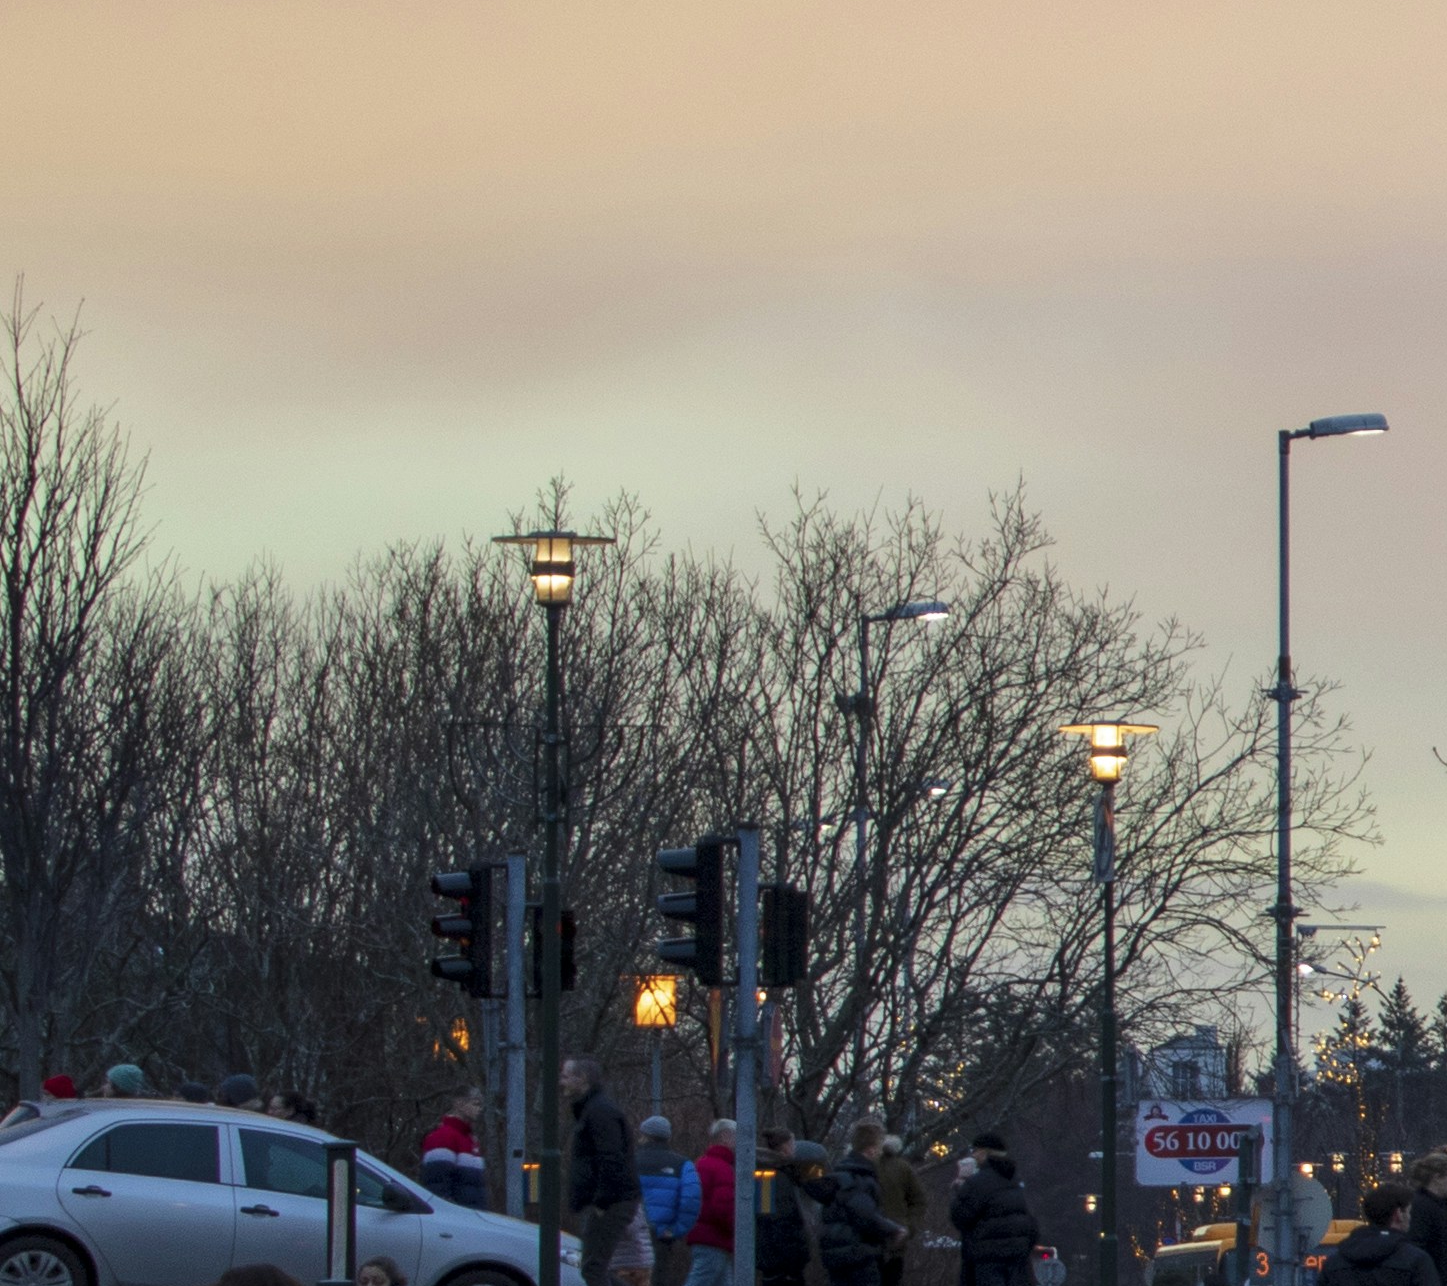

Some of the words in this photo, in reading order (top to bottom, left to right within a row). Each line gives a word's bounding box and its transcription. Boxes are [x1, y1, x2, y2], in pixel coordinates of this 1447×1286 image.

[1193, 1114, 1217, 1124] TAXI
[1153, 1130, 1180, 1153] 56
[1186, 1130, 1211, 1151] 10
[1216, 1130, 1241, 1151] 00
[1194, 1161, 1217, 1172] BSR
[1255, 1251, 1271, 1278] 3
